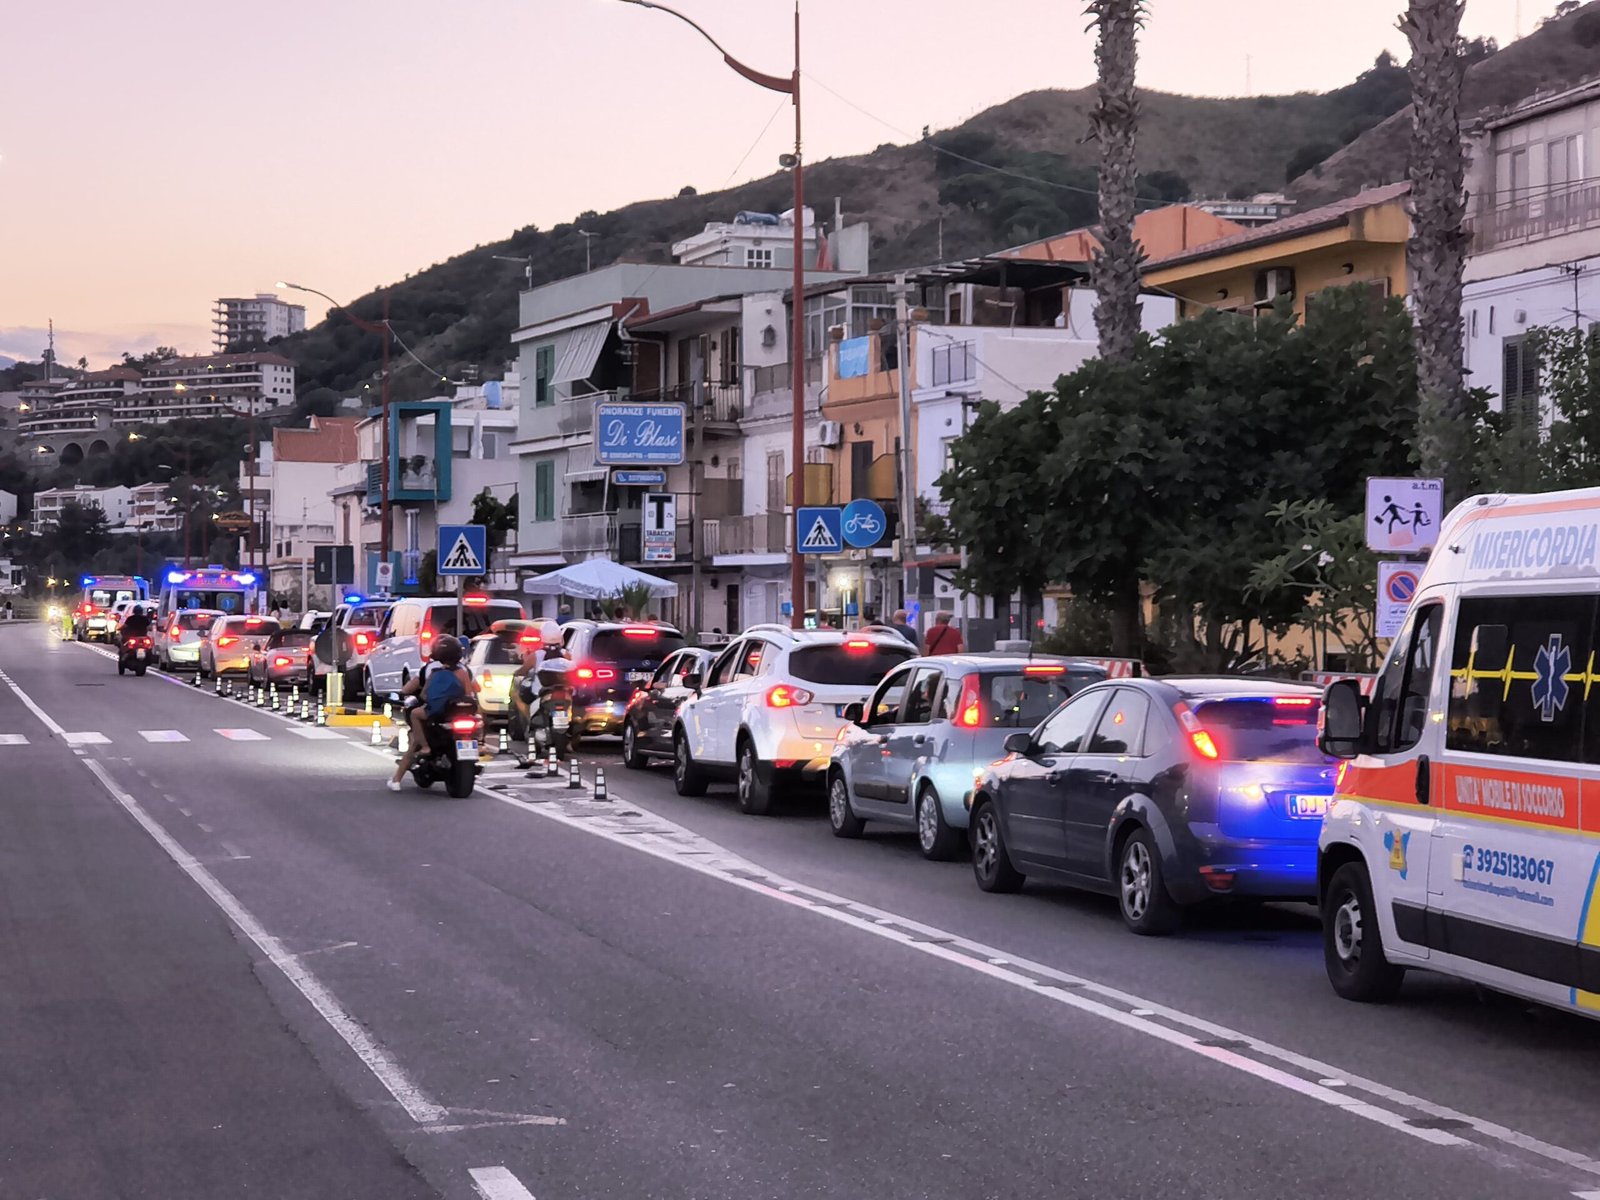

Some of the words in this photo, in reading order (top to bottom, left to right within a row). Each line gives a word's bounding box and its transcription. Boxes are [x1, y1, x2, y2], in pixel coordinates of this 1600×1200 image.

[601, 407, 643, 416] ONORANZE
[647, 408, 681, 416] FUNEBRI
[603, 419, 631, 446] Di
[634, 419, 681, 446] Blasi
[648, 496, 673, 529] T
[1470, 524, 1598, 569] MISERICORDIA
[1481, 778, 1511, 810] MOBILE
[1511, 782, 1523, 812] DI
[1522, 784, 1565, 818] SOCCORSO
[1476, 847, 1555, 886] 3925133067
